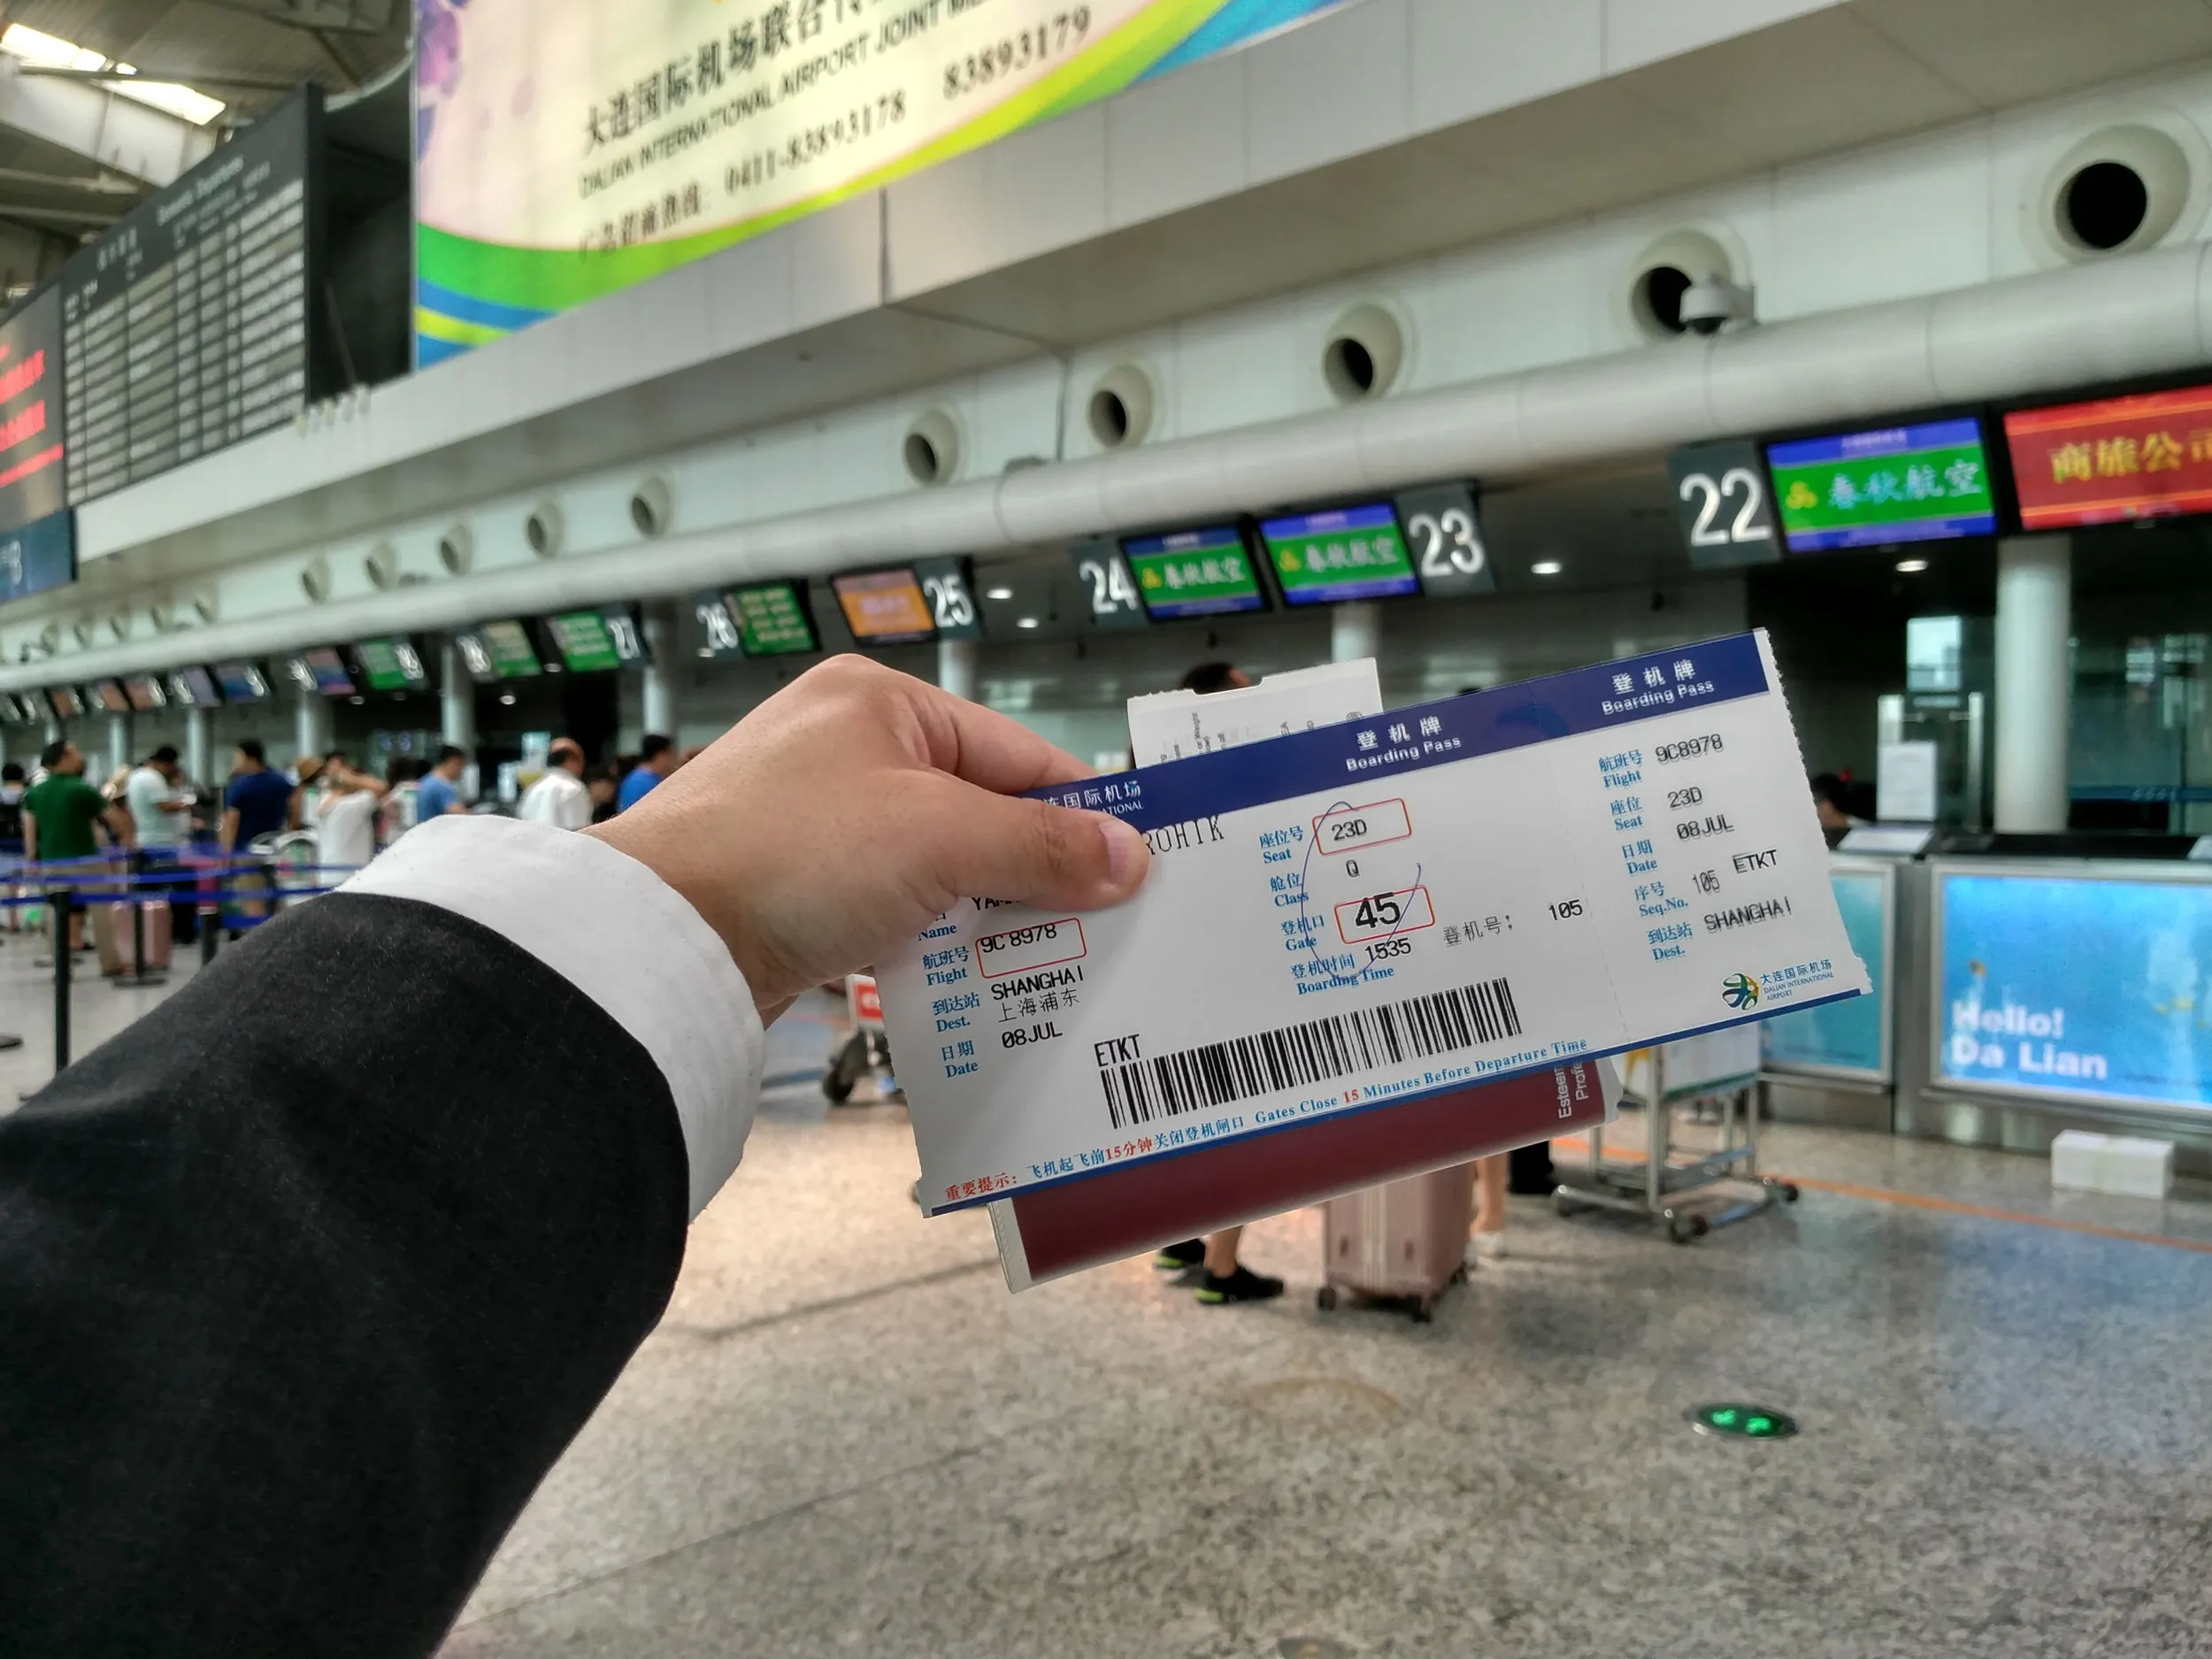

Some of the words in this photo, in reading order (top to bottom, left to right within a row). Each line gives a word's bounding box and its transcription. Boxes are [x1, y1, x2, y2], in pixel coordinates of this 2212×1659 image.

[943, 4, 1092, 100] 83893179
[582, 0, 872, 157] 大连国际机场联合
[639, 81, 776, 170] INTERNATIONAL
[779, 31, 872, 102] AIRPORT
[875, 0, 943, 54] JOINT
[1828, 458, 1983, 511] 春秋航空
[1679, 468, 1770, 547] 22
[1409, 508, 1485, 577] 23
[1079, 556, 1137, 614] 24
[923, 574, 973, 627] 25
[1612, 658, 1696, 695] 登机牌
[1601, 687, 1674, 716] Boarding
[1678, 680, 1716, 699] Pass
[1356, 715, 1444, 752] 登机牌
[1346, 747, 1420, 772] Boarding
[1423, 736, 1463, 758] Pass
[1599, 749, 1643, 772] 航班号
[1655, 733, 1724, 763] 9C8978
[1603, 770, 1643, 787] Flight
[1610, 797, 1643, 816] 座位
[1667, 786, 1703, 809] 23D
[1331, 818, 1368, 842] 23D
[1614, 816, 1644, 831] Seat
[1677, 814, 1734, 840] 08JUL
[1258, 826, 1304, 849] 座位号
[1621, 839, 1654, 859] 日期
[1263, 847, 1292, 864] Seat
[1627, 857, 1659, 875] Date
[1732, 849, 1778, 874] ETKT
[1345, 859, 1360, 879] Q
[1270, 872, 1302, 893] 舱位
[1634, 881, 1665, 902] 序号
[1692, 870, 1721, 895] 105
[1274, 891, 1310, 908] Class
[1354, 891, 1402, 930] 45
[1548, 899, 1584, 922] 105
[1639, 896, 1689, 918] Seq.No.
[1280, 914, 1325, 936] 登机口
[1703, 896, 1793, 933] SHANGHAI
[918, 923, 957, 941] Name
[979, 933, 1006, 954] 9C
[1009, 923, 1057, 948] 8978
[1285, 934, 1317, 952] Gate
[1647, 922, 1694, 945] 到达站
[923, 946, 970, 971] 航班号
[1364, 937, 1412, 964] 1535
[1652, 942, 1686, 961] Dest.
[926, 965, 968, 987] Flight
[1290, 952, 1356, 979] 登机时间
[1760, 959, 1832, 985] 大连国际机场
[990, 964, 1084, 1001] SHANGHAI
[1296, 969, 1359, 996] Boarding
[1359, 964, 1395, 985] Time
[1763, 982, 1786, 994] DALIAN
[1787, 972, 1834, 988] INTERNATIONAL
[933, 991, 980, 1016] 到达站
[998, 987, 1079, 1024] 上海浦东
[1766, 989, 1793, 1002] AIRPORT
[935, 1017, 971, 1033] Dest.
[1951, 998, 2065, 1040] Hello!
[1002, 1021, 1064, 1048] 08JUL
[941, 1040, 975, 1062] 日期
[1094, 1033, 1143, 1067] ETKT
[1949, 1034, 2006, 1069] Da
[2018, 1041, 2108, 1080] Lian
[945, 1061, 979, 1079] Date
[1255, 1106, 1295, 1124] Gates
[1300, 1094, 1338, 1114] Close
[1342, 1089, 1360, 1104] 15
[1363, 1075, 1421, 1099] Minutes
[1424, 1064, 1471, 1087] Before
[1474, 1046, 1548, 1075] Departure
[1550, 1037, 1588, 1056] Time
